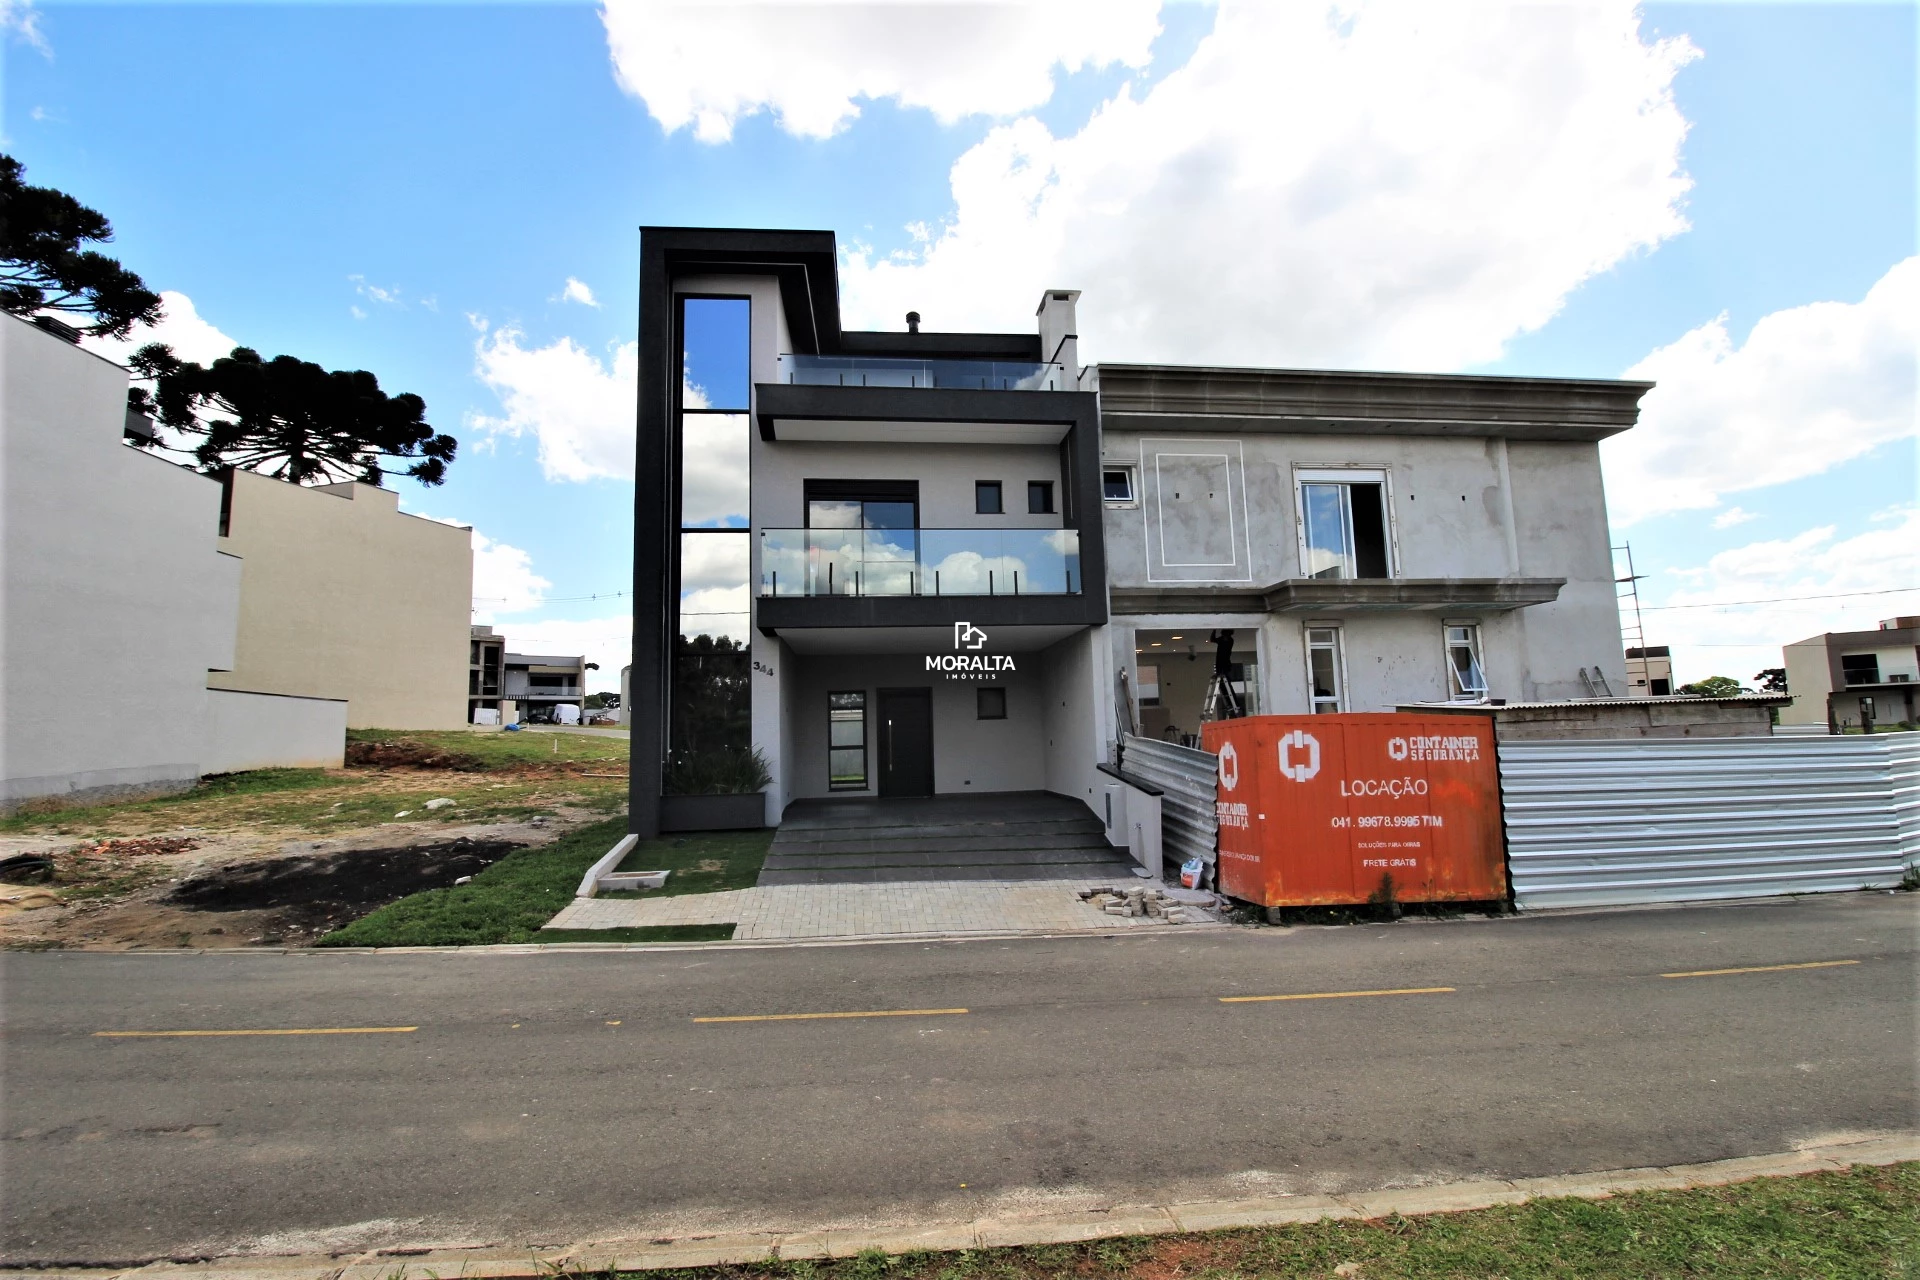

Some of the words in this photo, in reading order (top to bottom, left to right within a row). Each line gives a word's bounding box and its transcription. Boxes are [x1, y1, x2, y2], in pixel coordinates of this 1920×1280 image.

[753, 661, 774, 677] 344
[1409, 736, 1479, 749] CONTAINER
[1410, 749, 1480, 763] SEGURANÇA
[1340, 776, 1428, 800] LOCAÇÃO
[1217, 815, 1249, 831] EGURANÇA
[1421, 815, 1443, 827] TIM
[1363, 859, 1388, 867] FRETE
